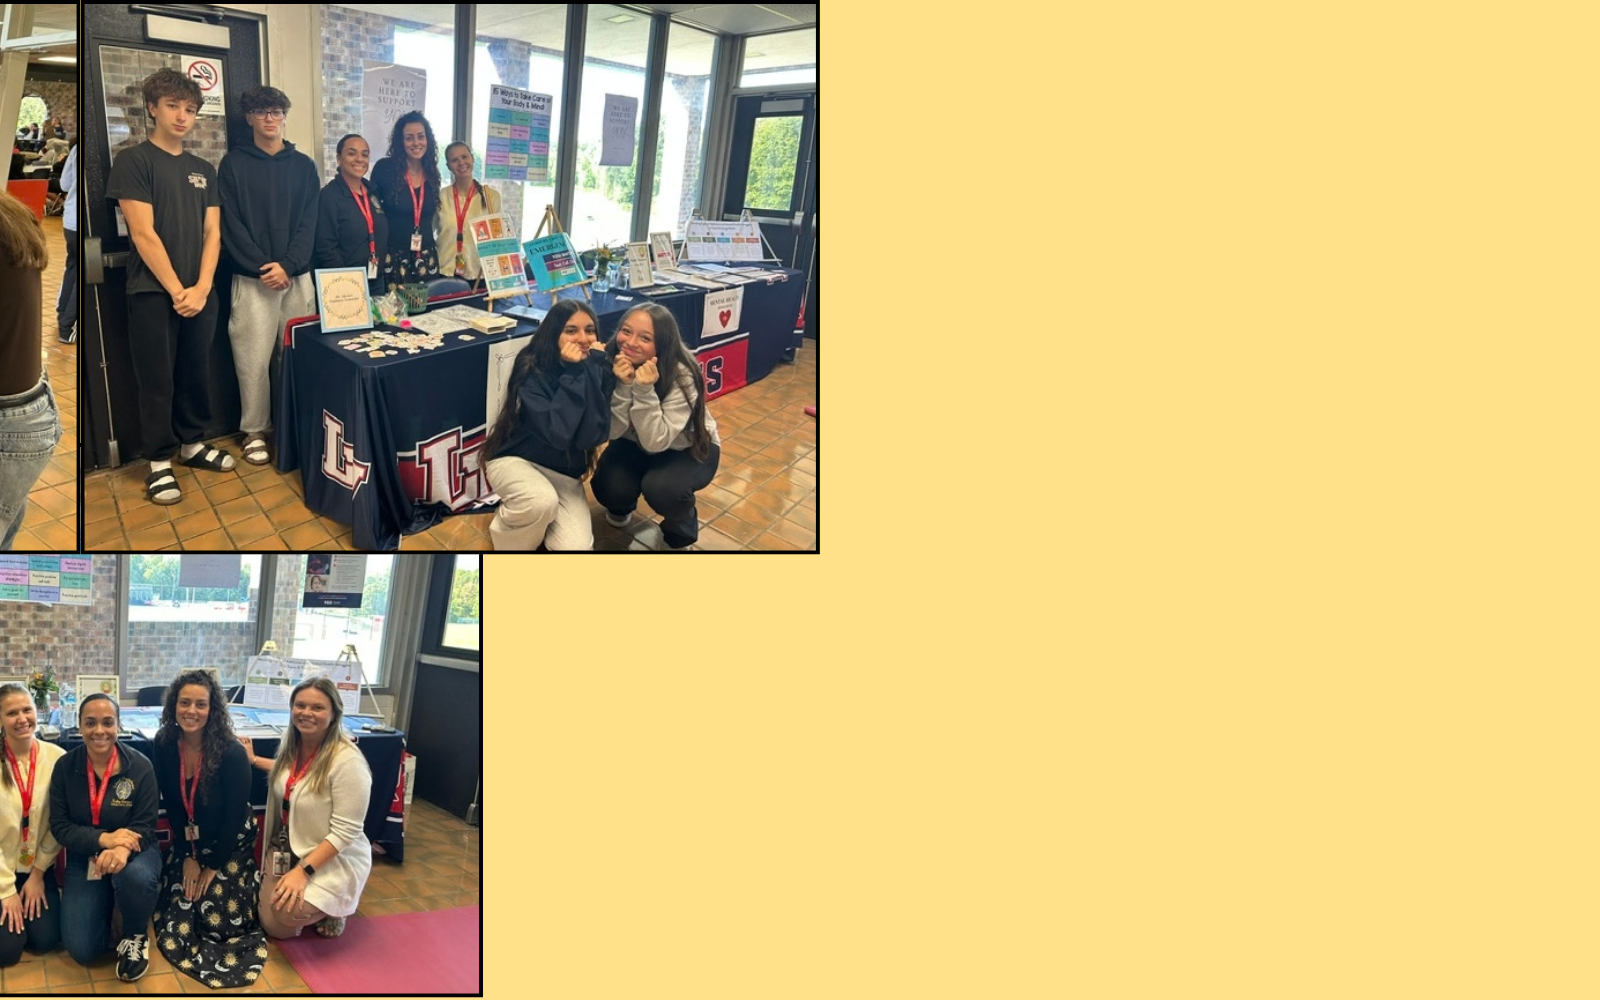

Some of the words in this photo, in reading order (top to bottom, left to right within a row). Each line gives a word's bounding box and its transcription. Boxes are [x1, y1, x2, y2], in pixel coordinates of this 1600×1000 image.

[379, 86, 400, 96] HERE
[404, 90, 416, 98] TO
[378, 96, 416, 107] SUPPORT
[532, 94, 546, 103] Care
